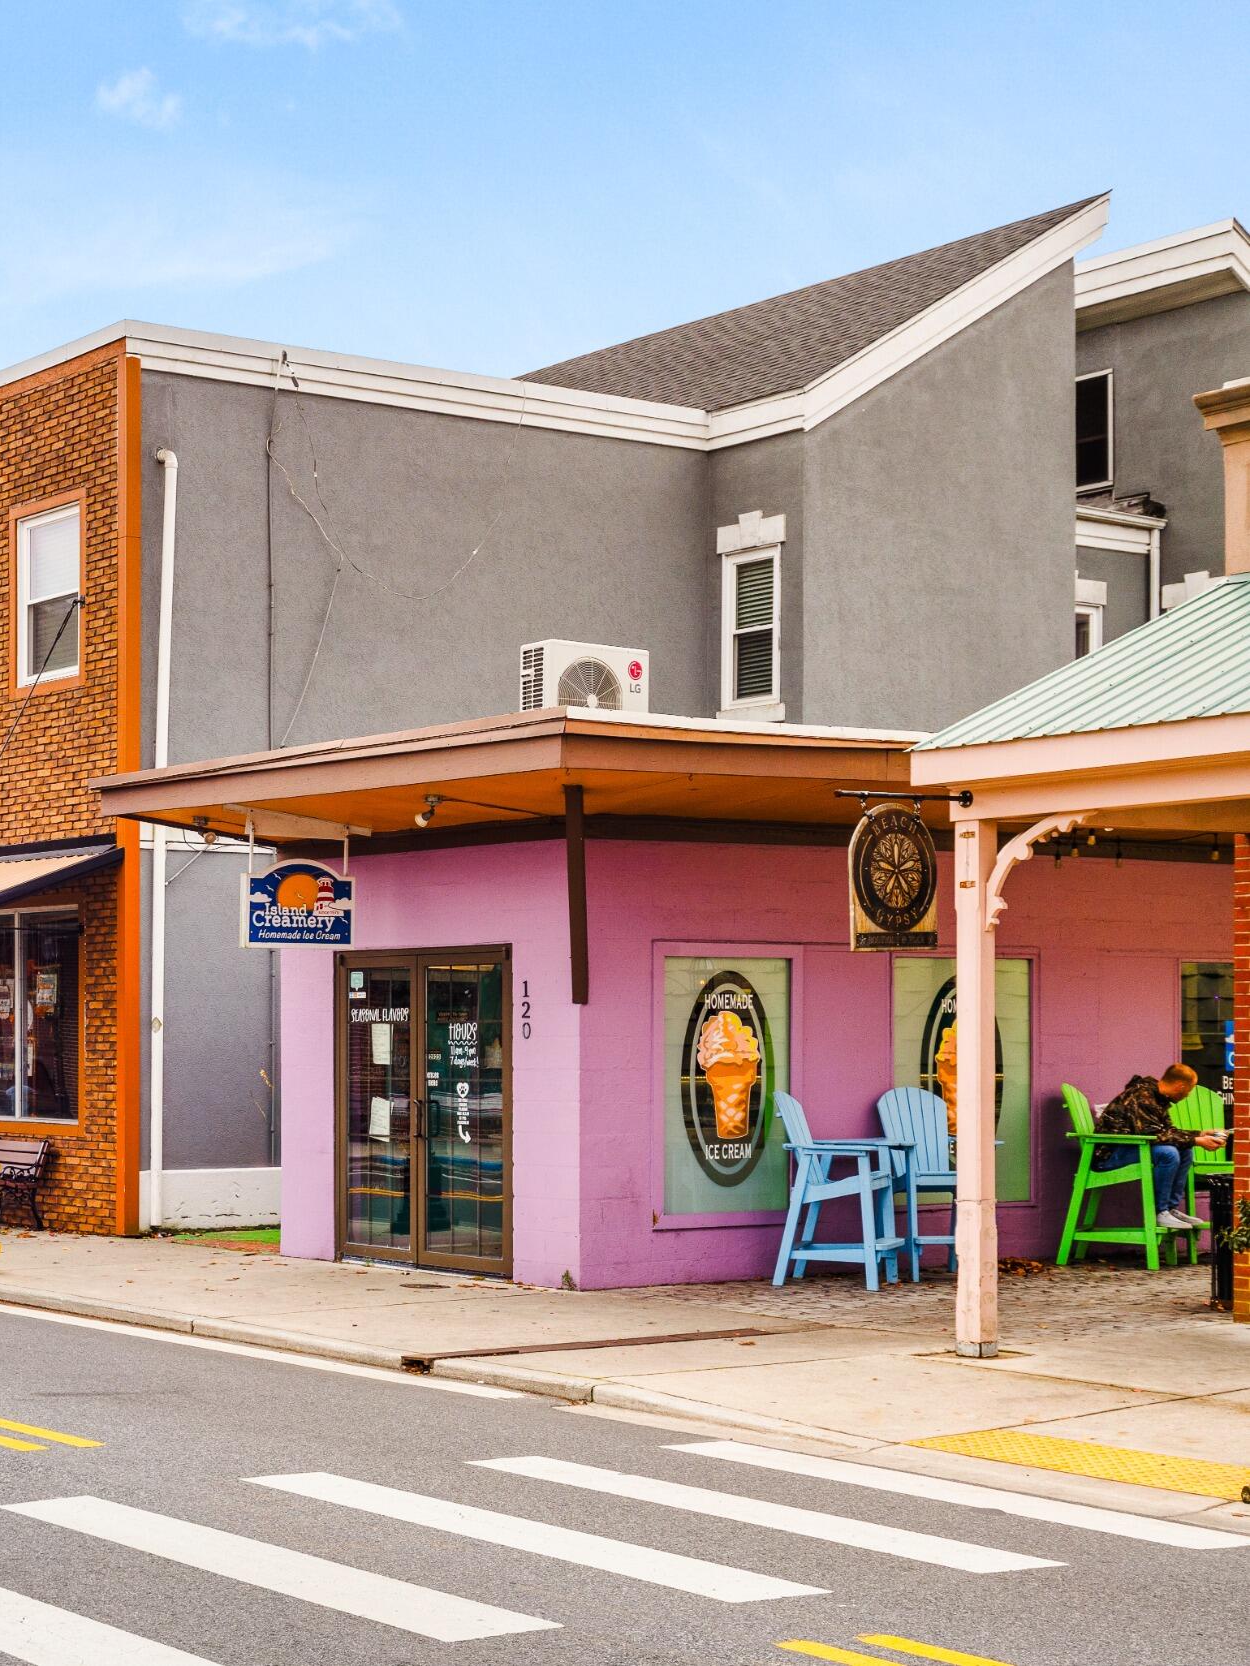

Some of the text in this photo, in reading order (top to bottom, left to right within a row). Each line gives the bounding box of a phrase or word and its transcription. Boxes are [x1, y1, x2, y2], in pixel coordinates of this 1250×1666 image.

[630, 683, 641, 693] LG
[871, 815, 918, 835] BEACH
[265, 903, 307, 916] Island
[876, 907, 919, 928] GYPSY
[252, 911, 336, 932] Creamery
[258, 929, 341, 940] Homemade Ice Cream
[521, 980, 531, 1040] 120
[704, 994, 754, 1010] HOMEMADE
[351, 1008, 409, 1022] SEASONAL FLAVORS
[449, 1022, 478, 1040] HOURS
[705, 1144, 752, 1160] ICE CREAM
